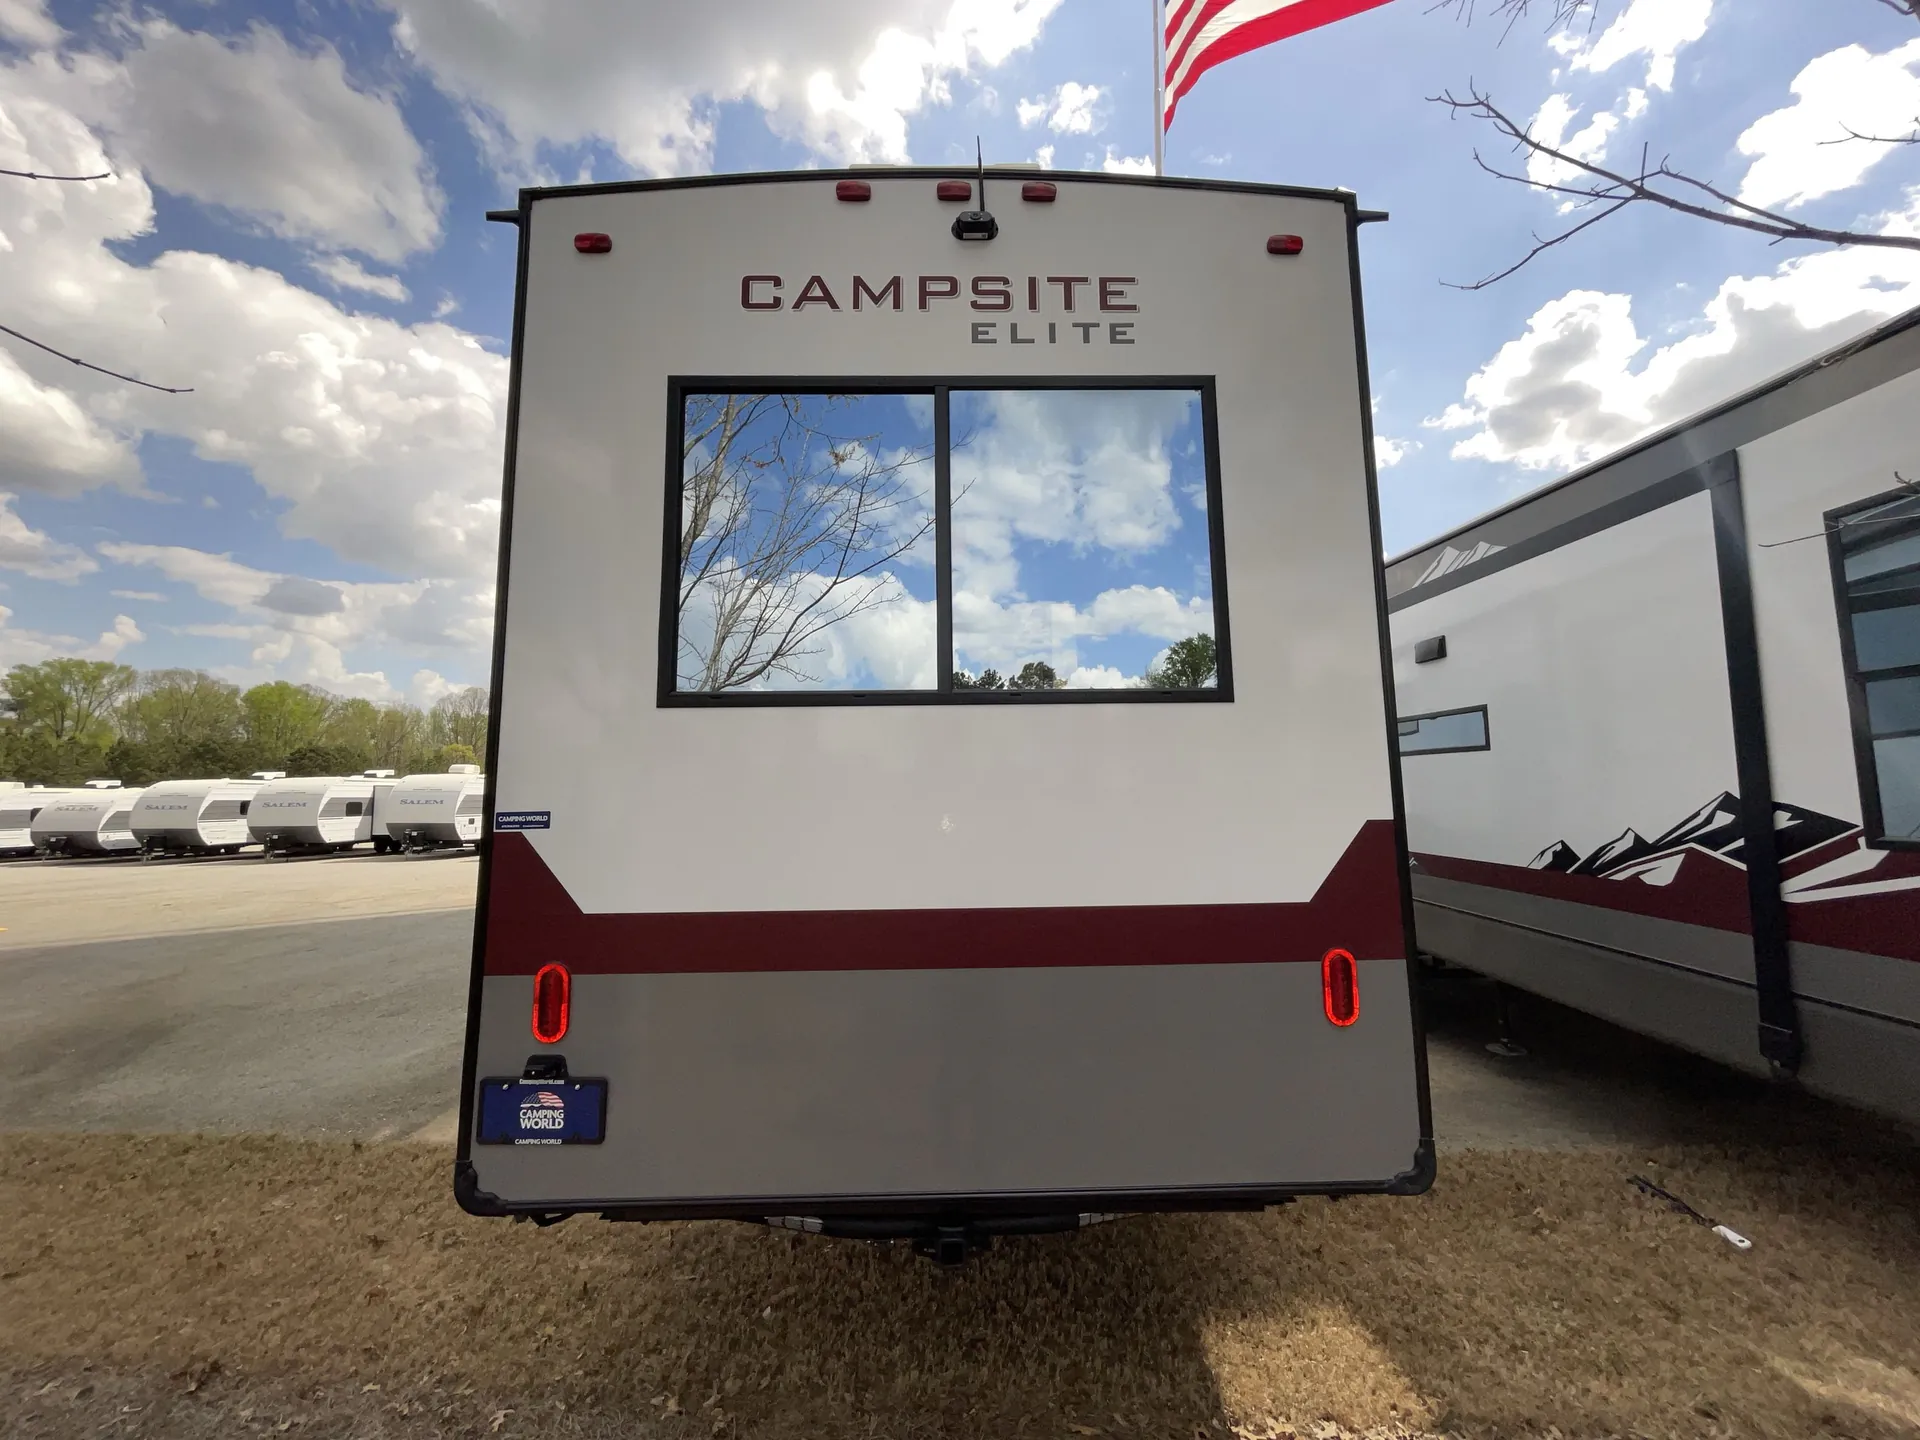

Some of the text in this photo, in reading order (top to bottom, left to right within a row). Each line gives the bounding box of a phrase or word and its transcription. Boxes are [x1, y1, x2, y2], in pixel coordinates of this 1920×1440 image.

[741, 274, 1140, 313] CAMPSITE
[971, 322, 1136, 345] ELITE
[519, 1109, 565, 1119] CAMPING
[519, 1118, 565, 1129] WORLD
